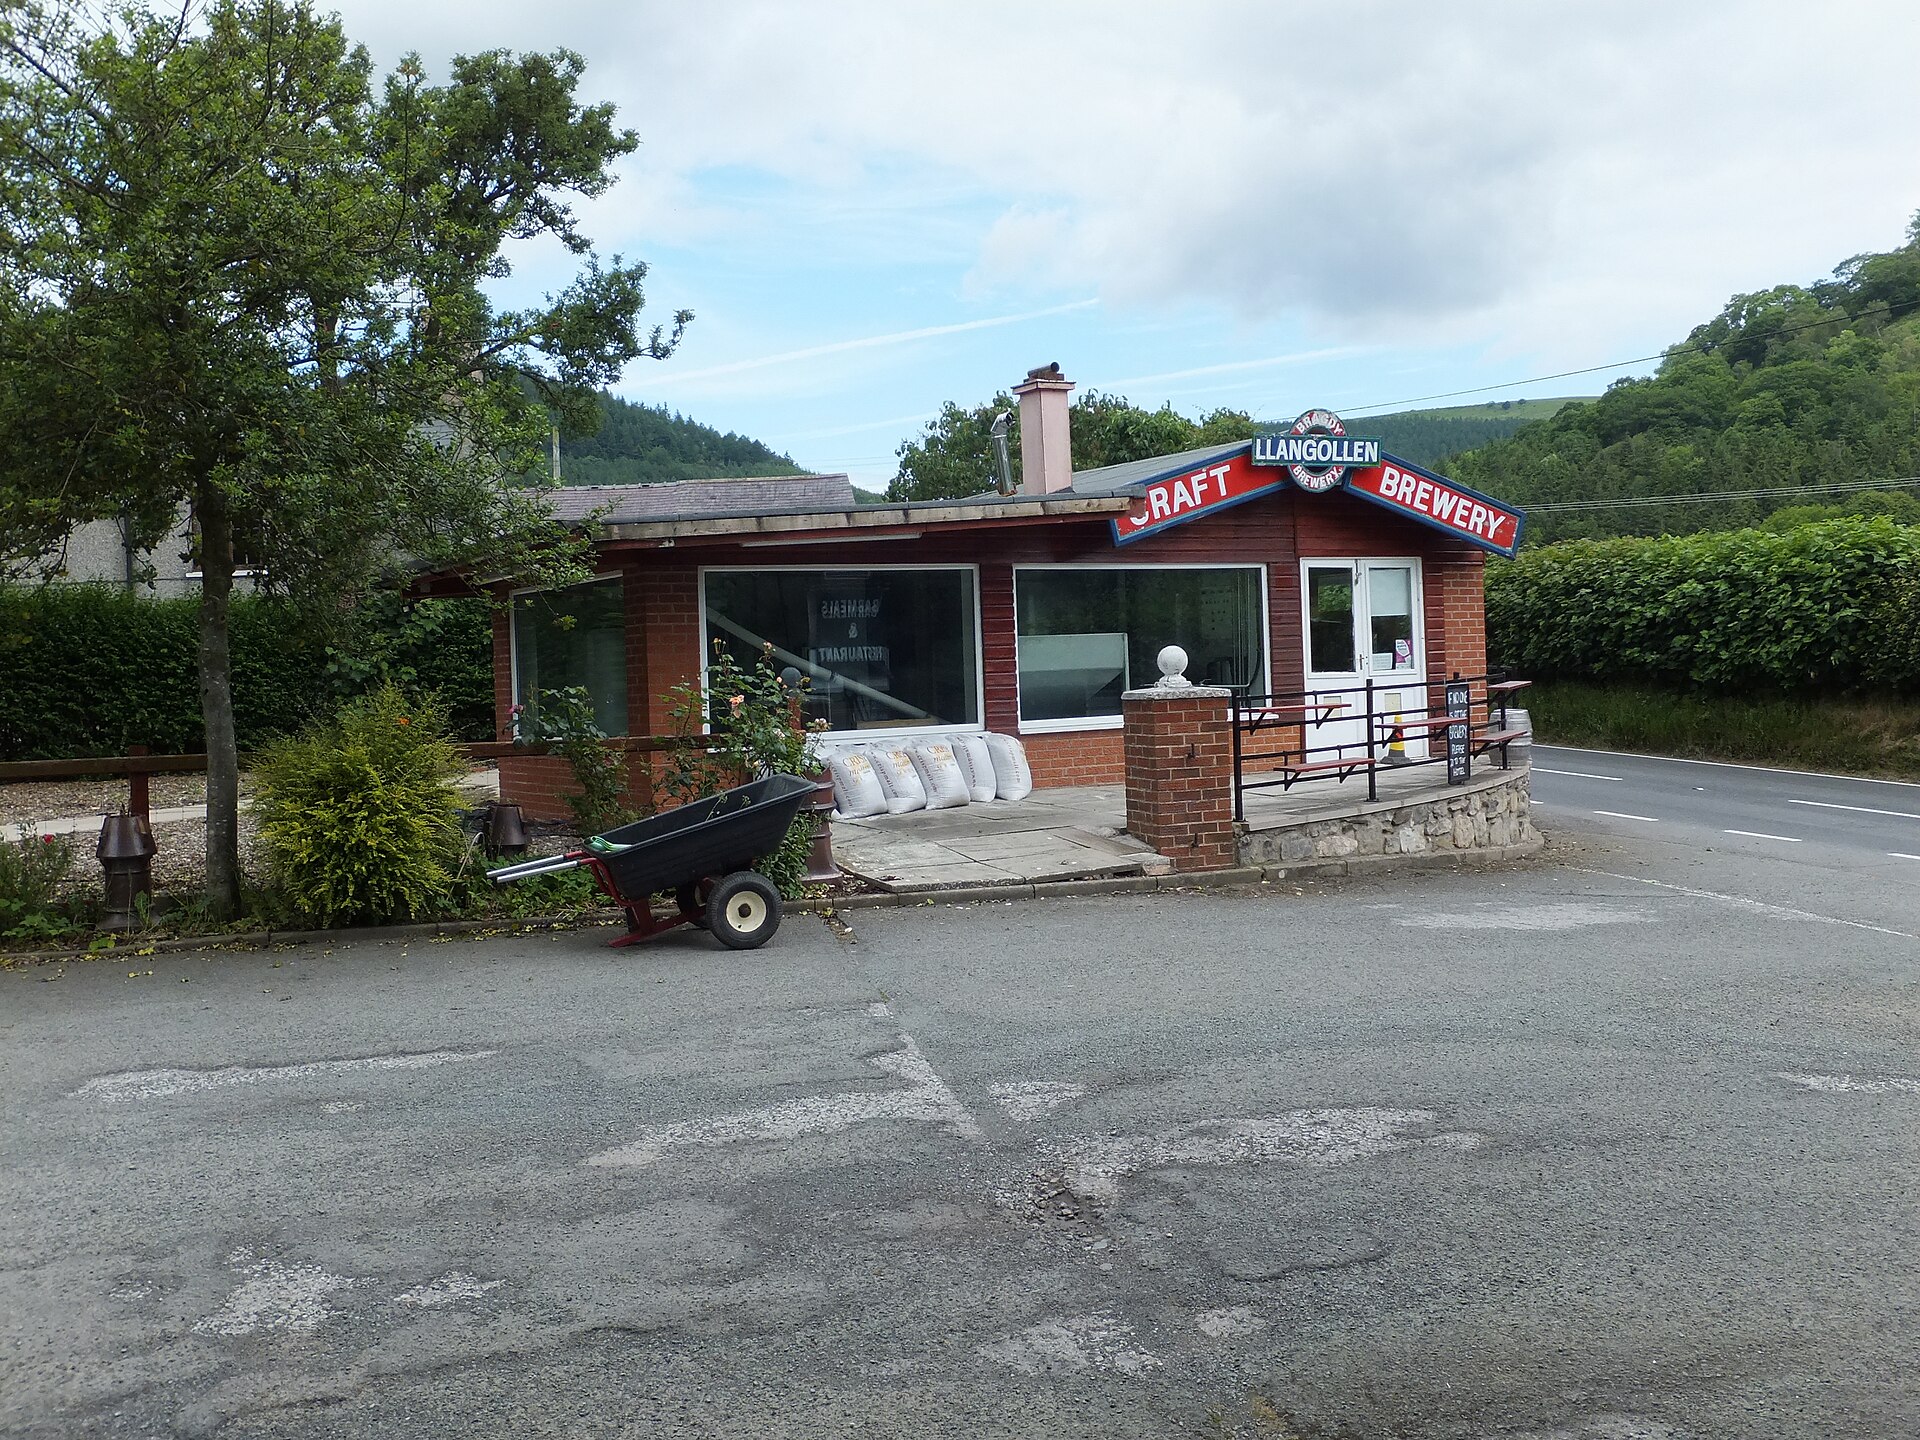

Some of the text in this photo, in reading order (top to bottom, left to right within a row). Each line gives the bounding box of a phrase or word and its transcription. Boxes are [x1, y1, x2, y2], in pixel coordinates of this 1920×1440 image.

[1295, 412, 1345, 435] BRAGDY
[1255, 438, 1379, 463] LLANGOLLEN
[1292, 465, 1344, 489] BREWERY
[1379, 465, 1507, 540] BREWERY
